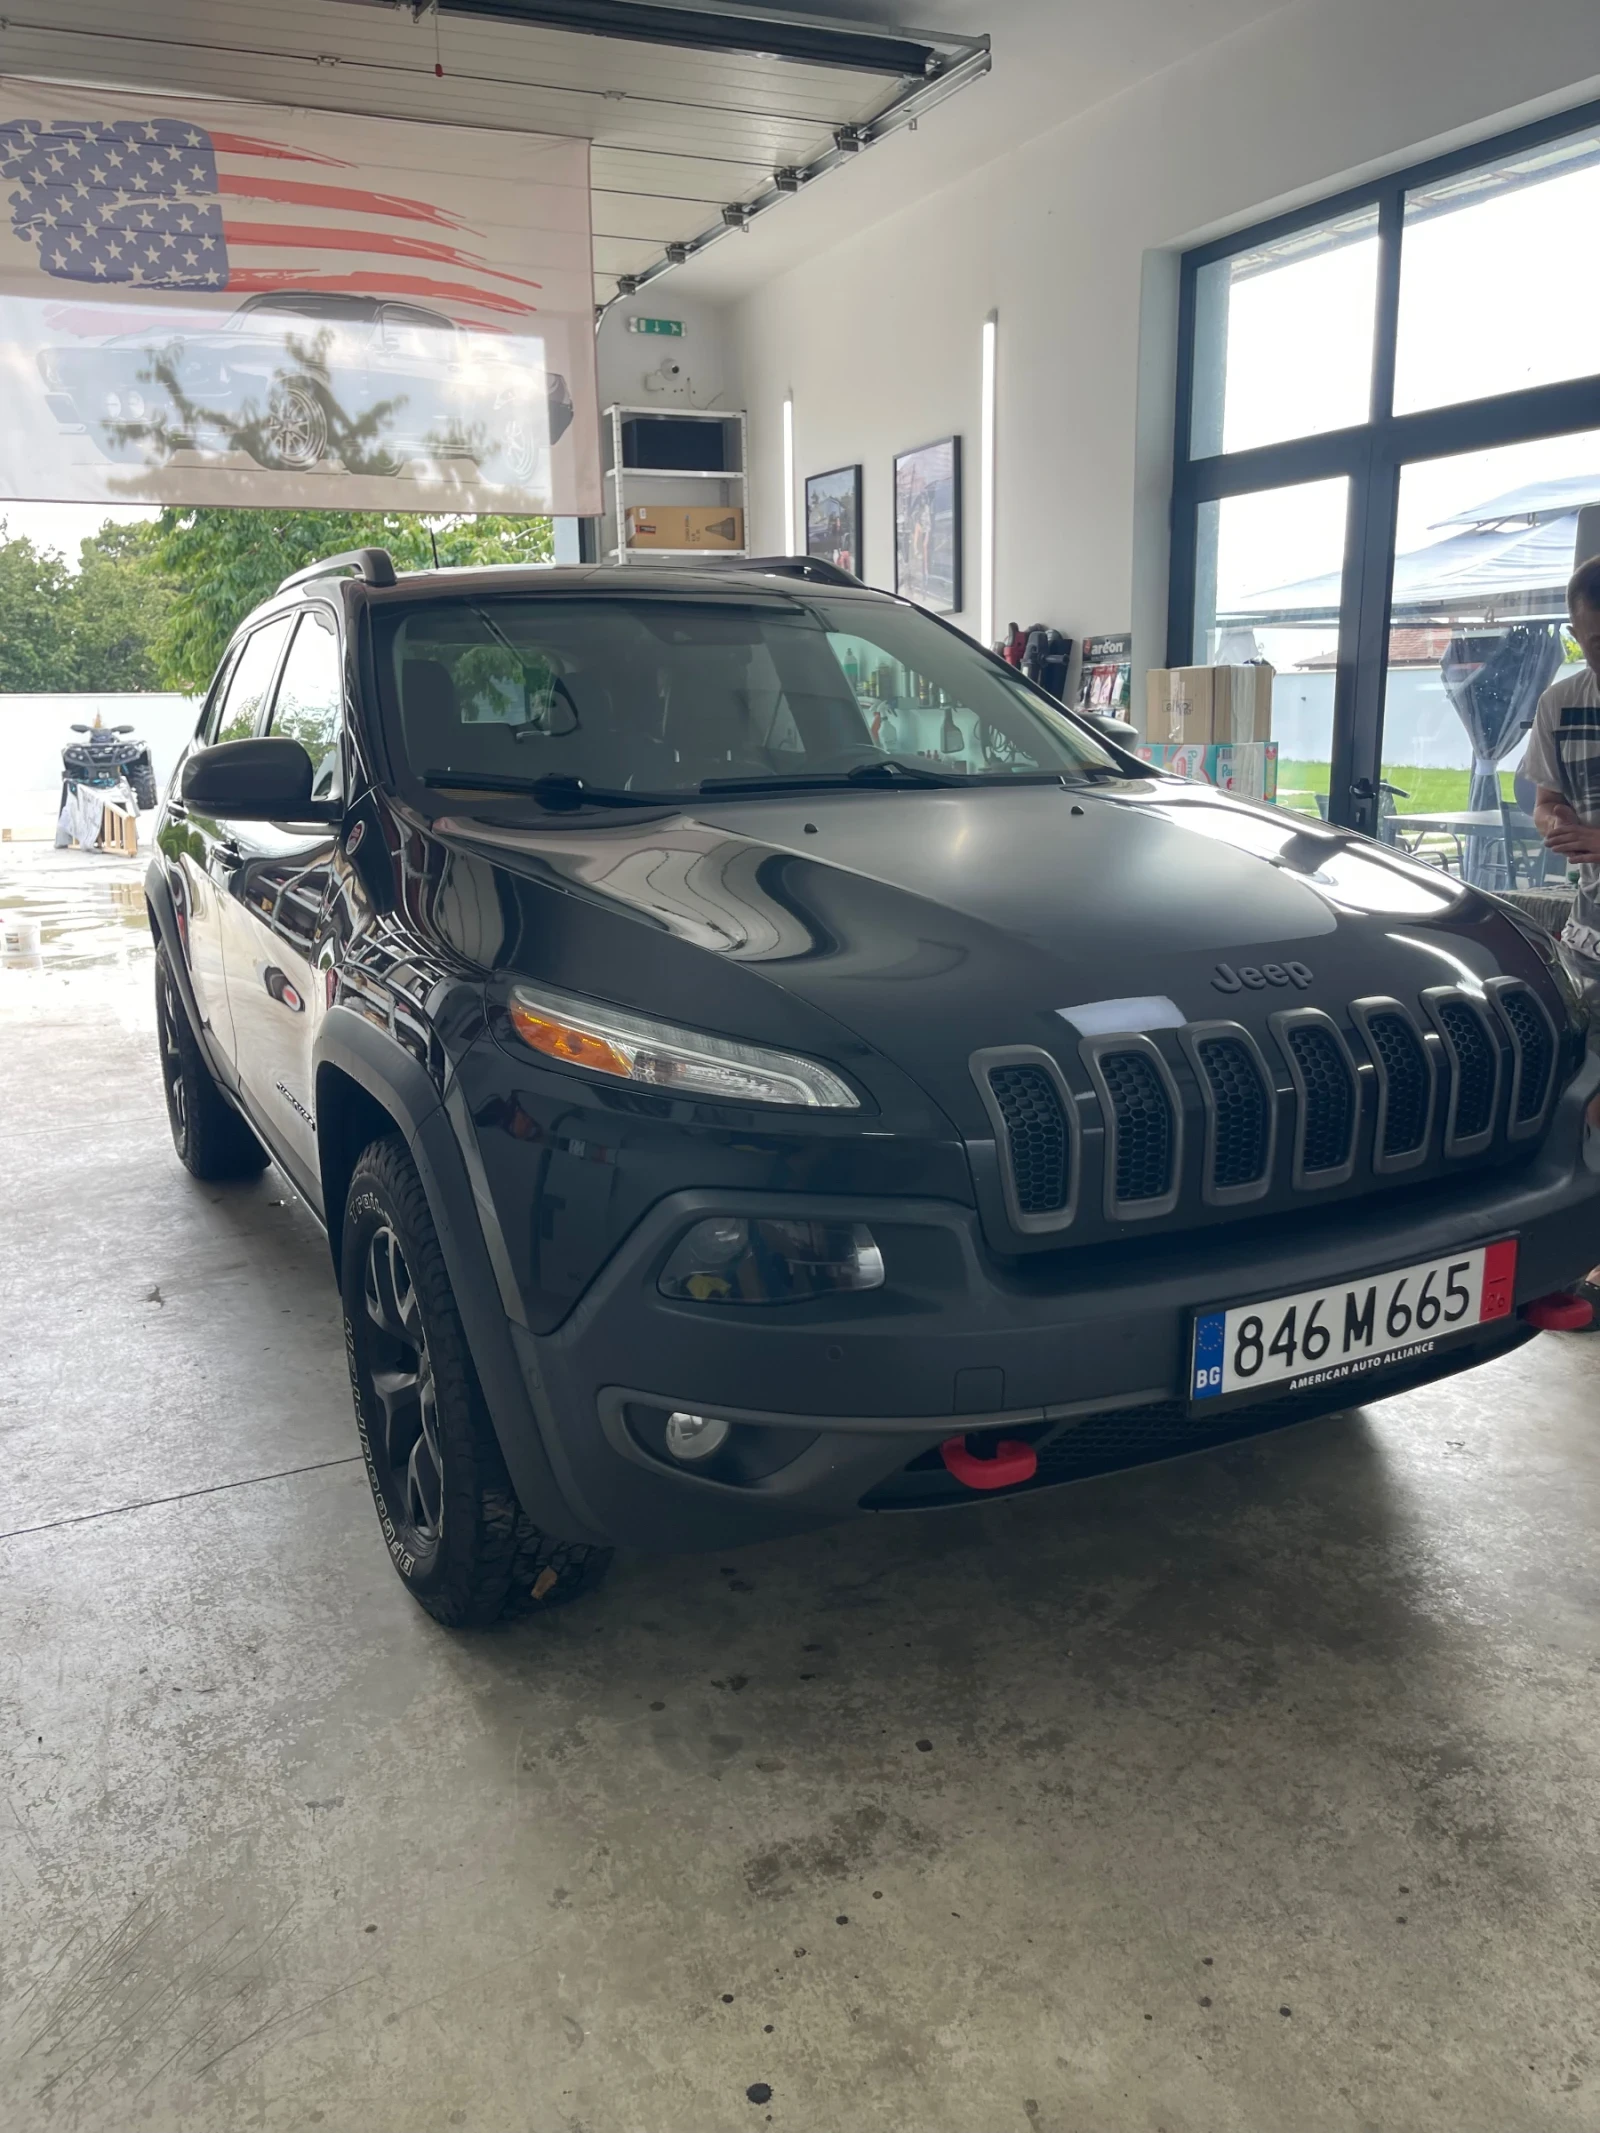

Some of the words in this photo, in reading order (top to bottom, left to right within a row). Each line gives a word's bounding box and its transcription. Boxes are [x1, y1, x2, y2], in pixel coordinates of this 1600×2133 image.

[1210, 961, 1313, 994] Jeep
[1233, 1299, 1331, 1378] 846
[1342, 1285, 1376, 1354] M
[1386, 1261, 1470, 1338] 665
[1196, 1366, 1221, 1389] BG
[1289, 1365, 1349, 1390] AMERICAN
[1351, 1356, 1382, 1374] AUTO
[1384, 1341, 1434, 1366] ALLIANCE
